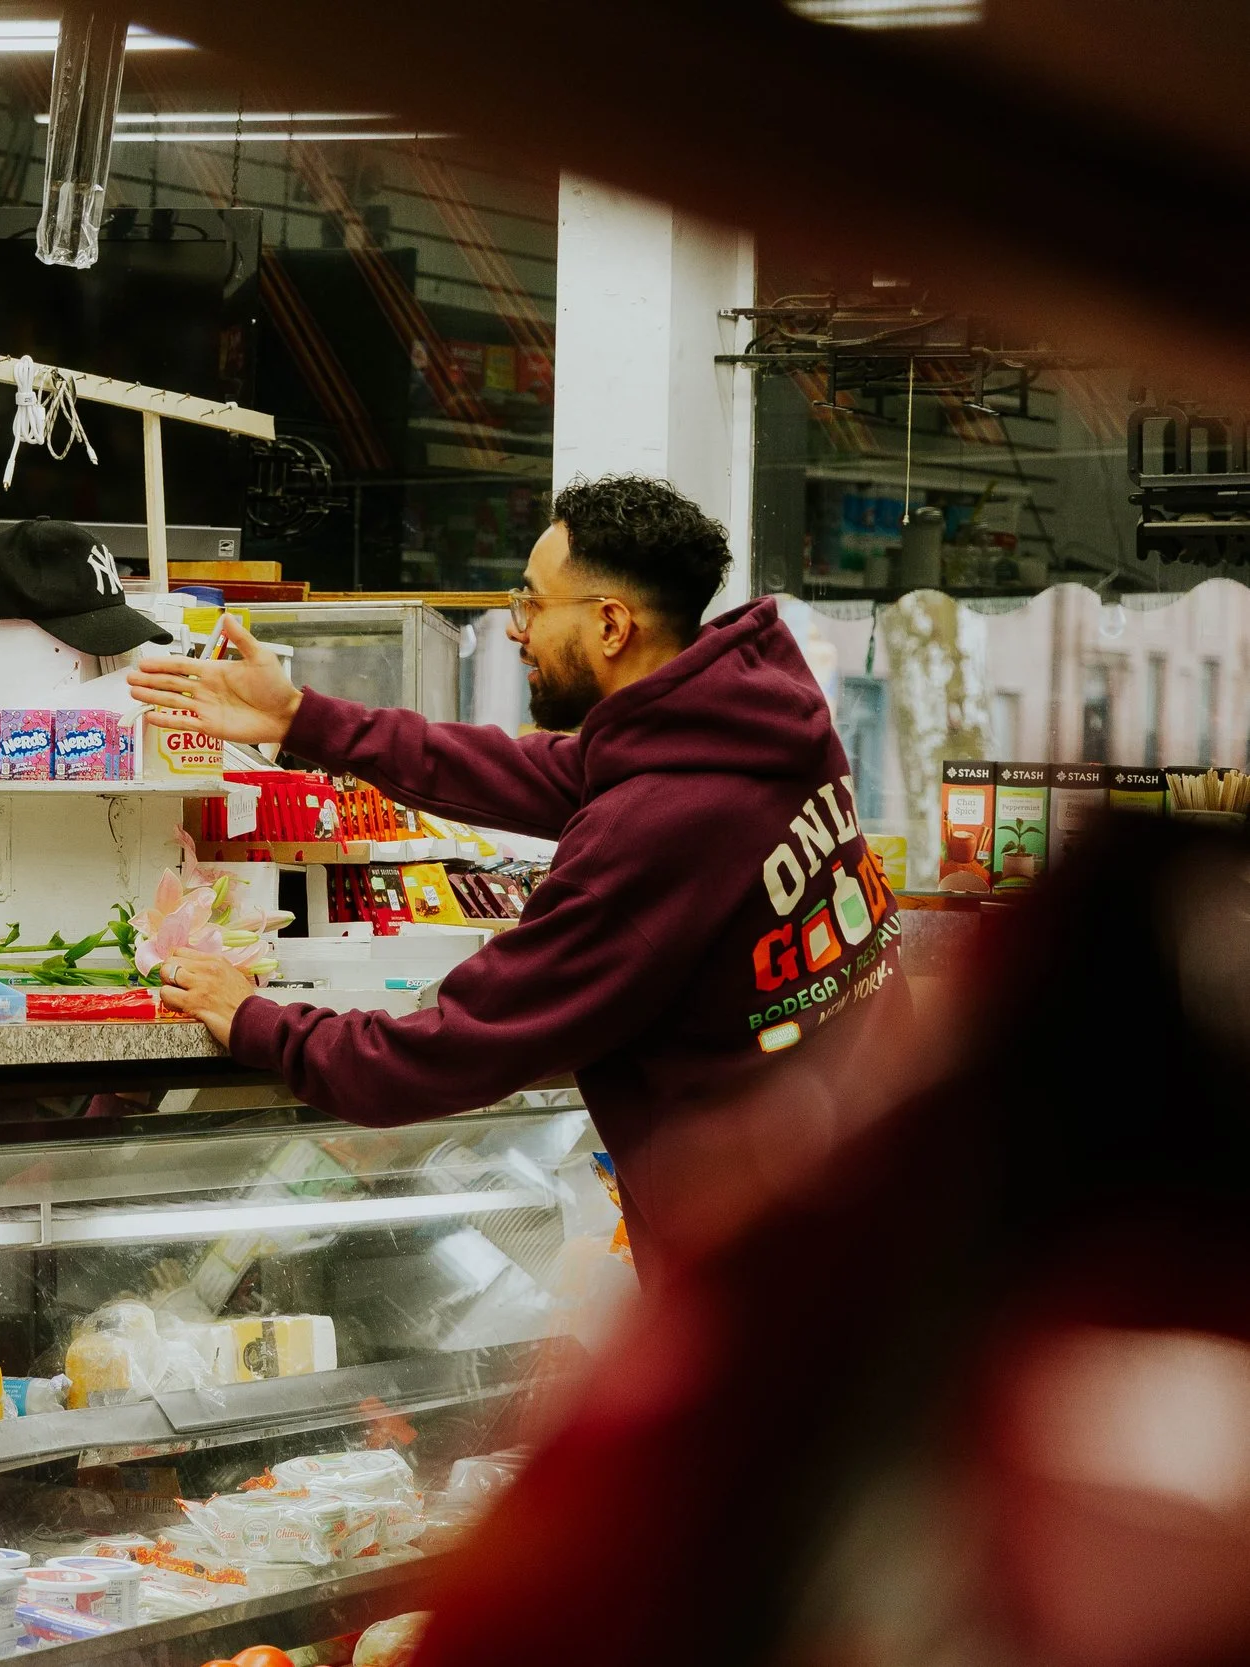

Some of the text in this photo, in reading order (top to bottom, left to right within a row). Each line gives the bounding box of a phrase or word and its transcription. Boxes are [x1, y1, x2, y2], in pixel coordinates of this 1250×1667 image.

[167, 733, 222, 751] GROCE
[958, 769, 989, 778] STASH
[1013, 771, 1044, 780] STASH
[1068, 773, 1100, 781] STASH
[1127, 775, 1159, 784] STASH
[957, 798, 976, 806] Chai
[955, 808, 977, 817] Spice
[1002, 804, 1040, 812] Peppermint
[749, 976, 839, 1029] BODEGA
[841, 964, 852, 984] Y
